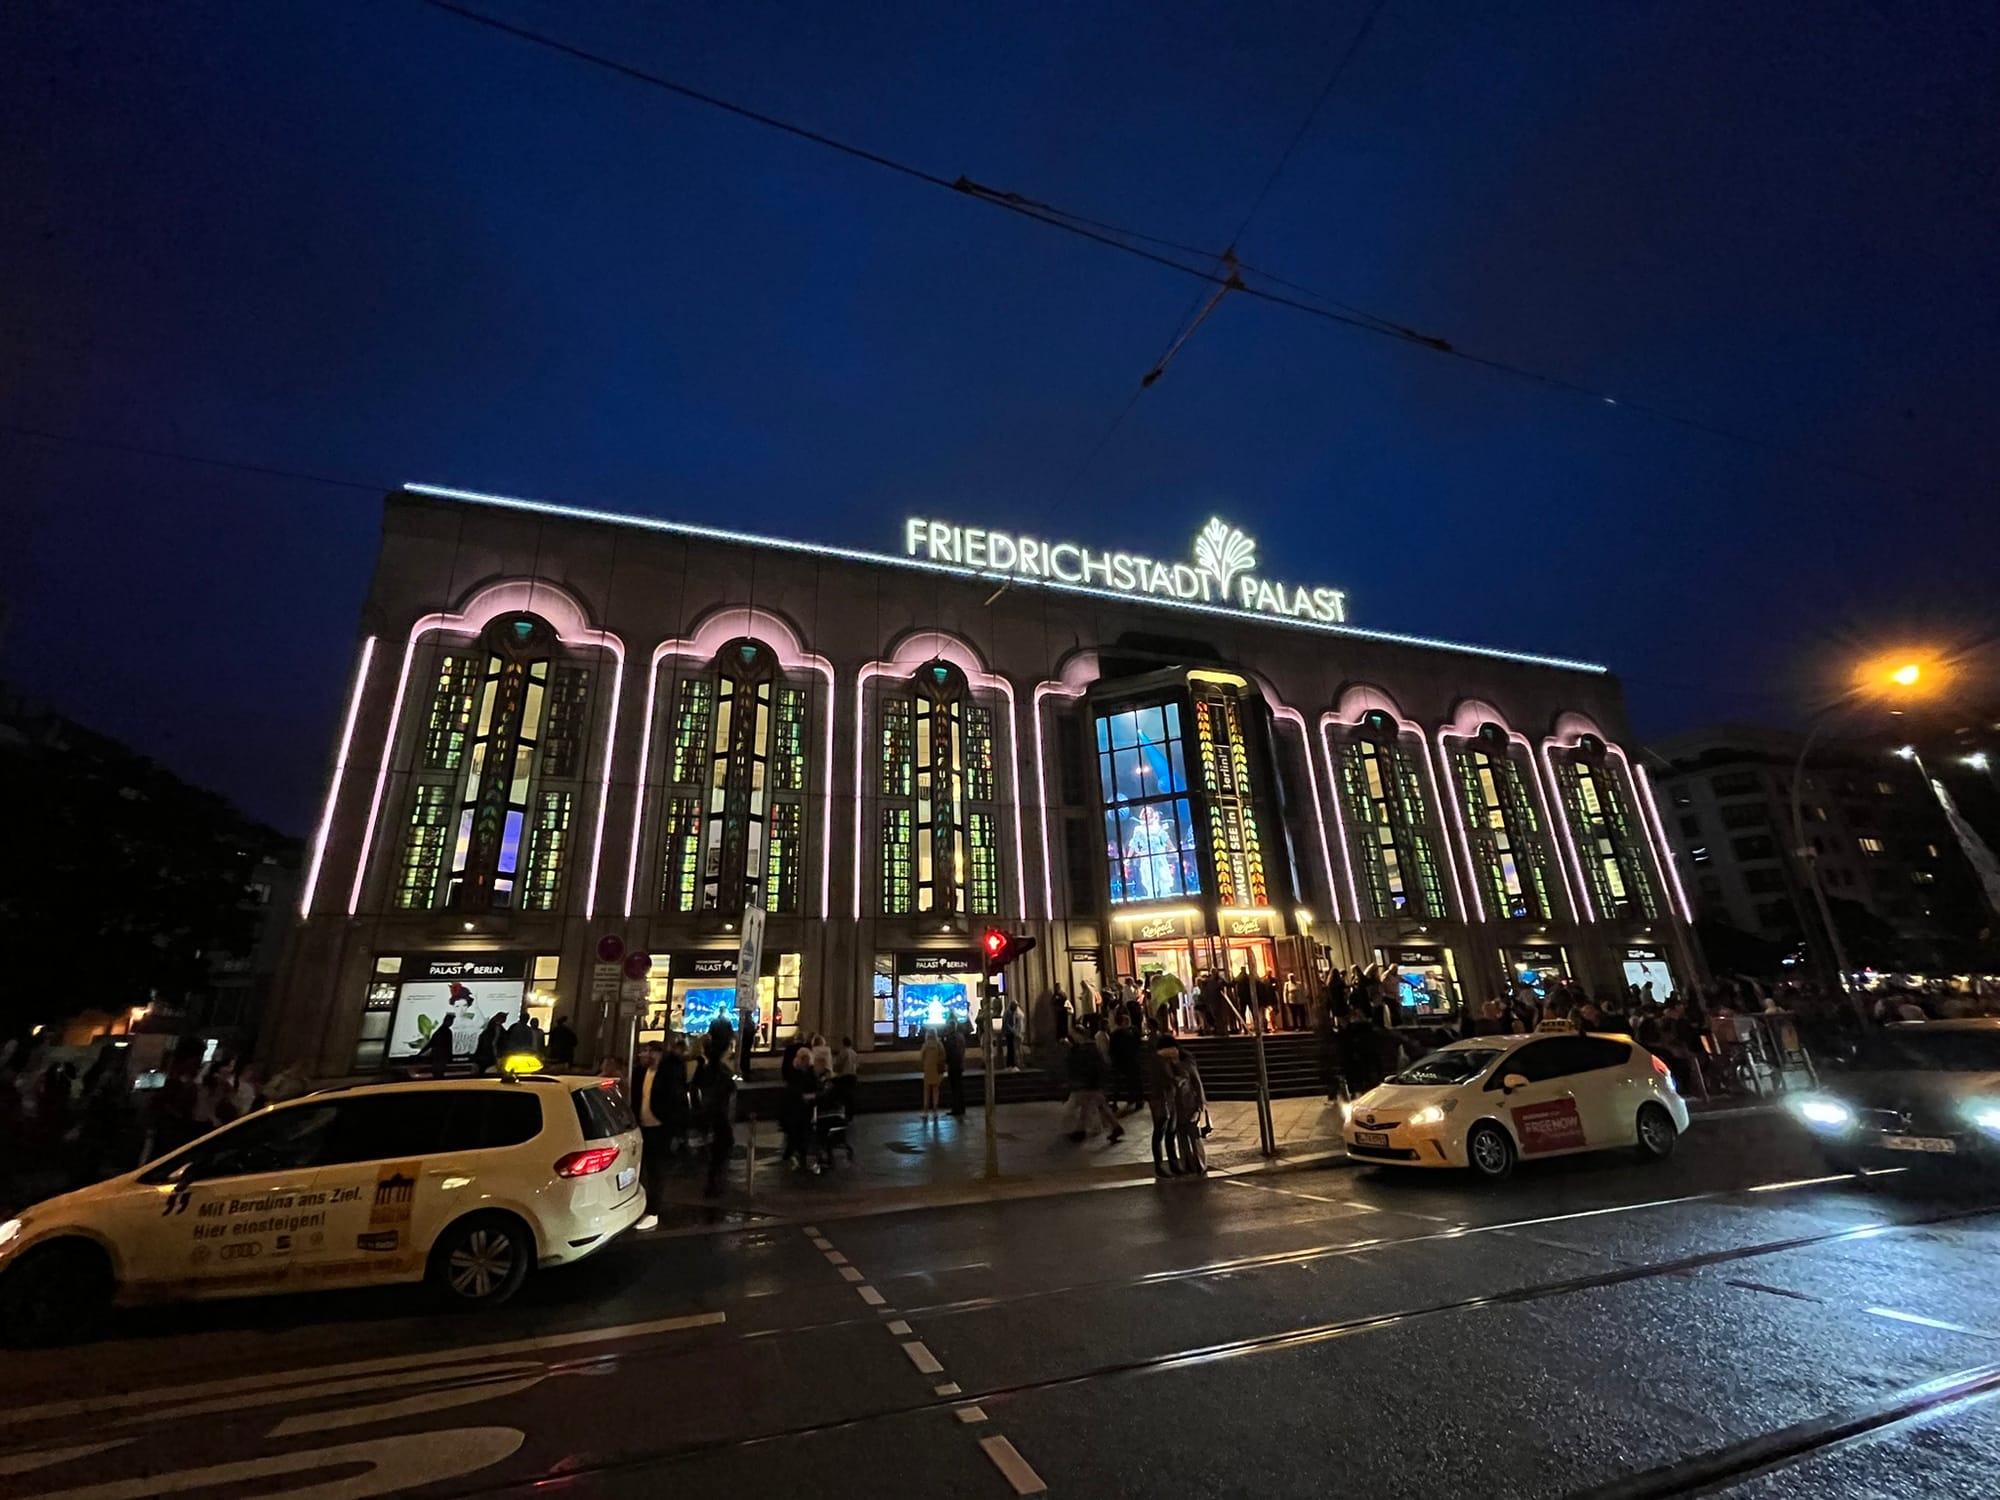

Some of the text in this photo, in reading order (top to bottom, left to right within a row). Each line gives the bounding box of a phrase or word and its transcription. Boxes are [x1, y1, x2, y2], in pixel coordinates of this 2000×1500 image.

[907, 518, 1348, 623] FRIEDRICHSTADT PALAST
[1227, 811, 1237, 824] in
[429, 965, 504, 975] PALAST BERLIN
[695, 963, 722, 972] PALAST
[198, 1201, 225, 1218] Mit
[229, 1194, 294, 1215] Berolina
[297, 1192, 327, 1207] ans
[193, 1211, 327, 1240] Hier einsteigen!
